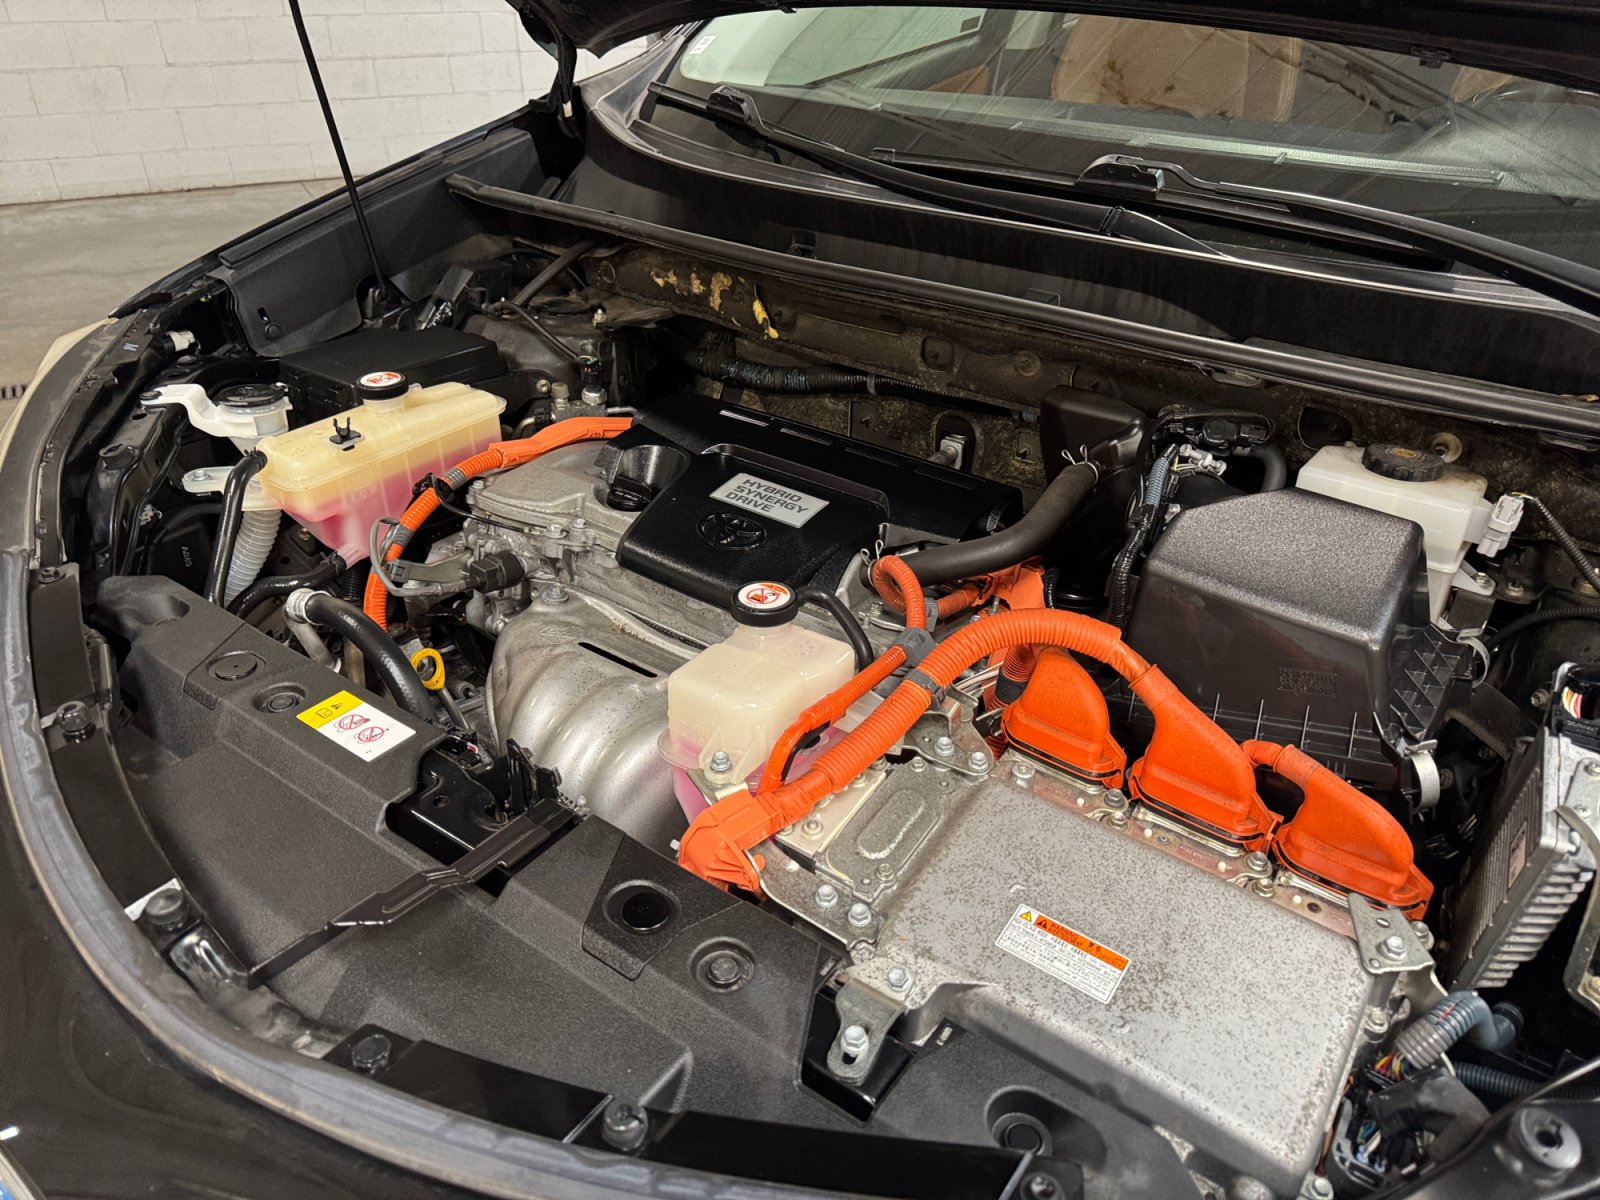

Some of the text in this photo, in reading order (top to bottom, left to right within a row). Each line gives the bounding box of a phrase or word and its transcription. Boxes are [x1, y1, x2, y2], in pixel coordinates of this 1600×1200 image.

[725, 491, 775, 513] DRIVE
[734, 485, 809, 514] SYNERGY
[742, 479, 802, 502] HYBRID
